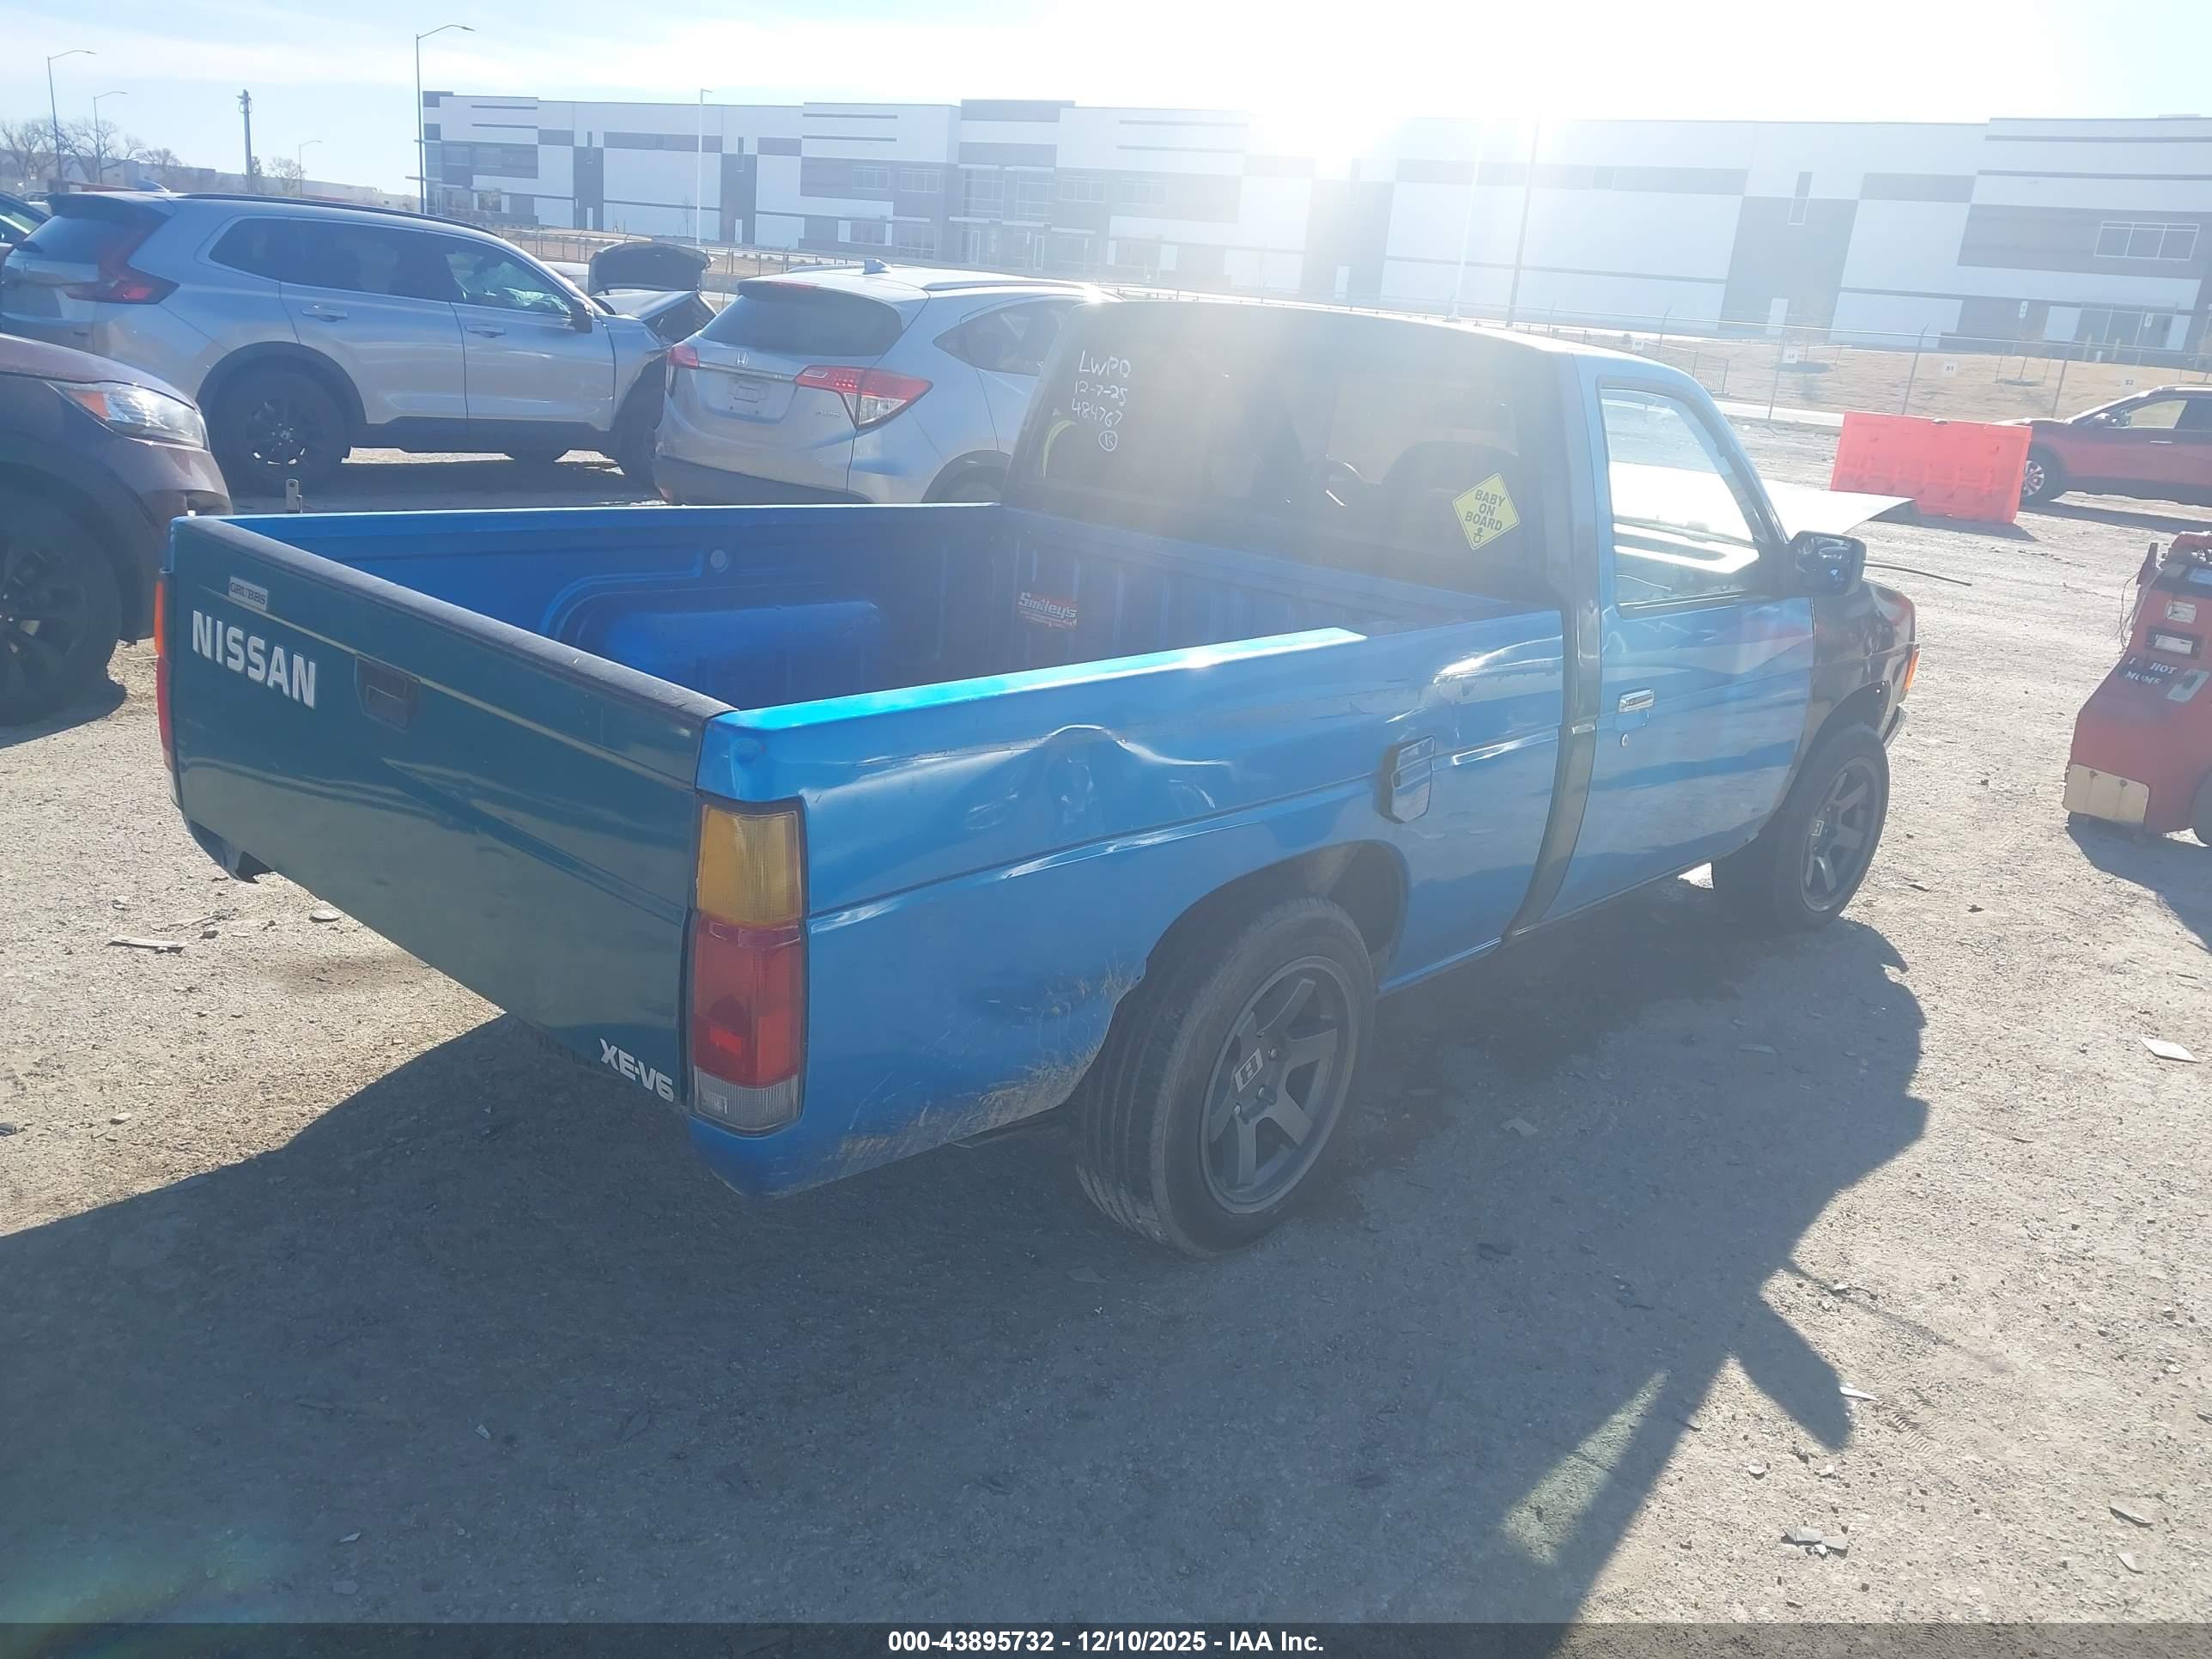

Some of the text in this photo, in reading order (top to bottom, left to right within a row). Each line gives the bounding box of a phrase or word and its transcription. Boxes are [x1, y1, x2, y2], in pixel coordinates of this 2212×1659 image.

[1079, 349, 1132, 378] LWPD
[1074, 380, 1128, 407] 12-7-25
[1474, 489, 1506, 507] BABY
[1478, 502, 1496, 517] ON
[1464, 510, 1503, 532] BOARD
[229, 581, 267, 605] GRUBBS
[192, 610, 316, 708] NISSAN
[2149, 661, 2179, 675] HOT
[599, 1037, 674, 1103] XE-V6
